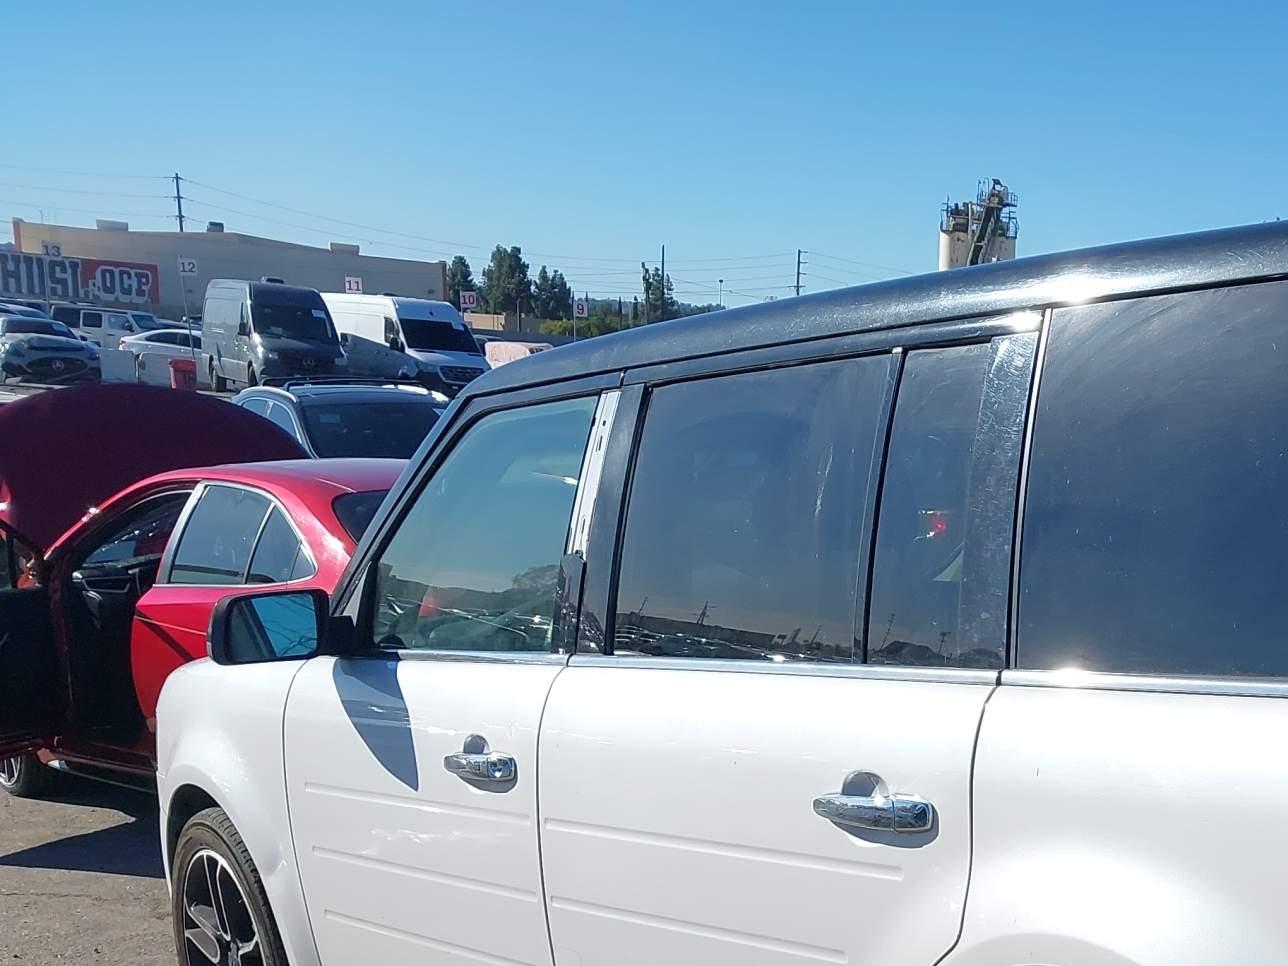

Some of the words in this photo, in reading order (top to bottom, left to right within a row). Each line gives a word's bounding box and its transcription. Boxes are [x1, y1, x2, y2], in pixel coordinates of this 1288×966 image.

[42, 245, 62, 258] 13
[179, 261, 197, 273] 12
[346, 279, 362, 292] 11
[461, 294, 476, 306] 10
[576, 303, 585, 315] 9
